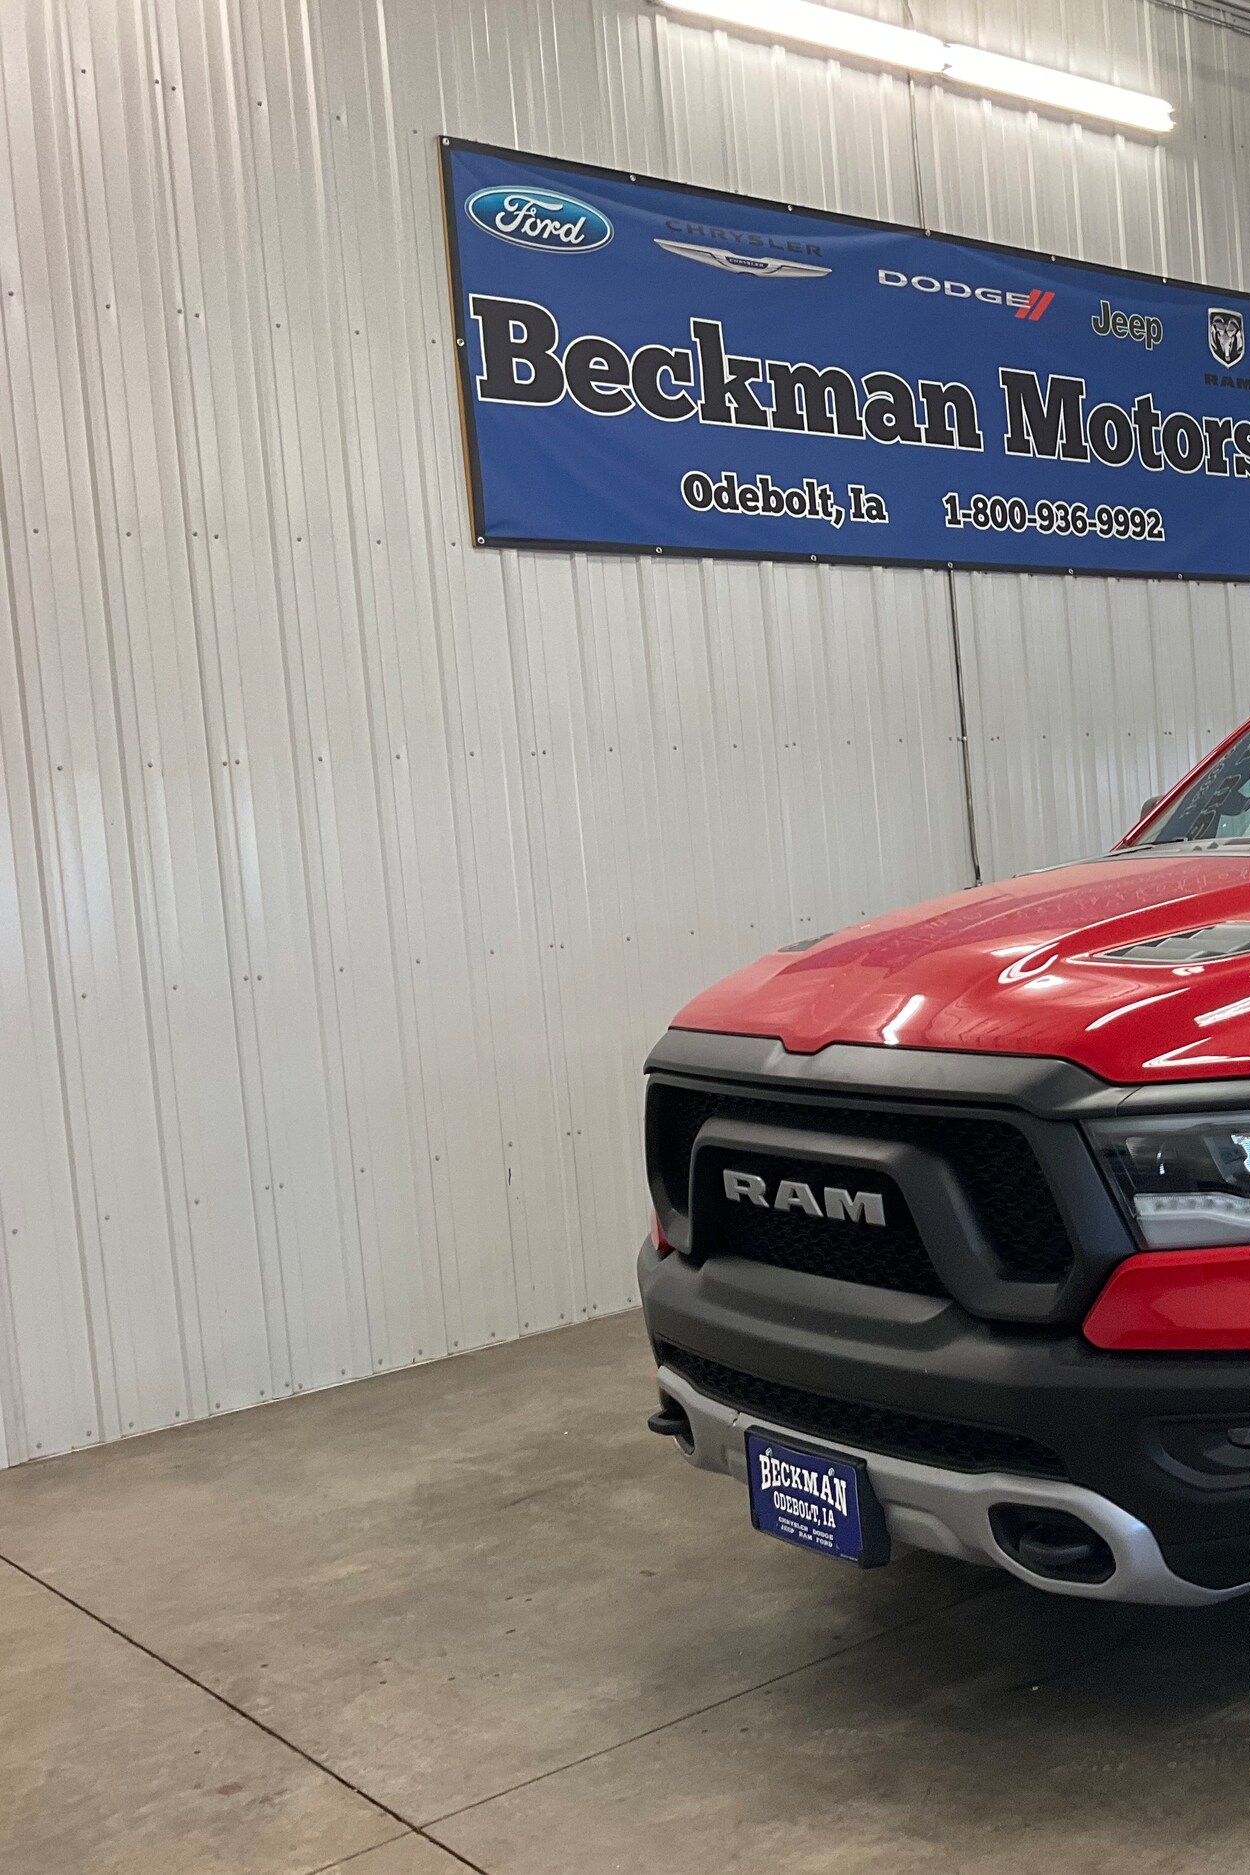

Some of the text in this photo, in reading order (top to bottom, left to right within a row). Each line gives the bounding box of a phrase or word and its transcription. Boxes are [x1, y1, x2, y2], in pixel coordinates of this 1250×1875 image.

[495, 194, 587, 244] Ford
[665, 218, 824, 257] CHRYSLER
[878, 269, 1031, 308] DODGE
[1091, 300, 1163, 350] Jeep
[469, 293, 984, 452] Beckman
[680, 470, 889, 529] Odebolt, Ia
[942, 493, 1166, 541] 1-800-936-9992
[723, 1169, 886, 1227] RAM
[759, 1454, 847, 1516] BECKMAN
